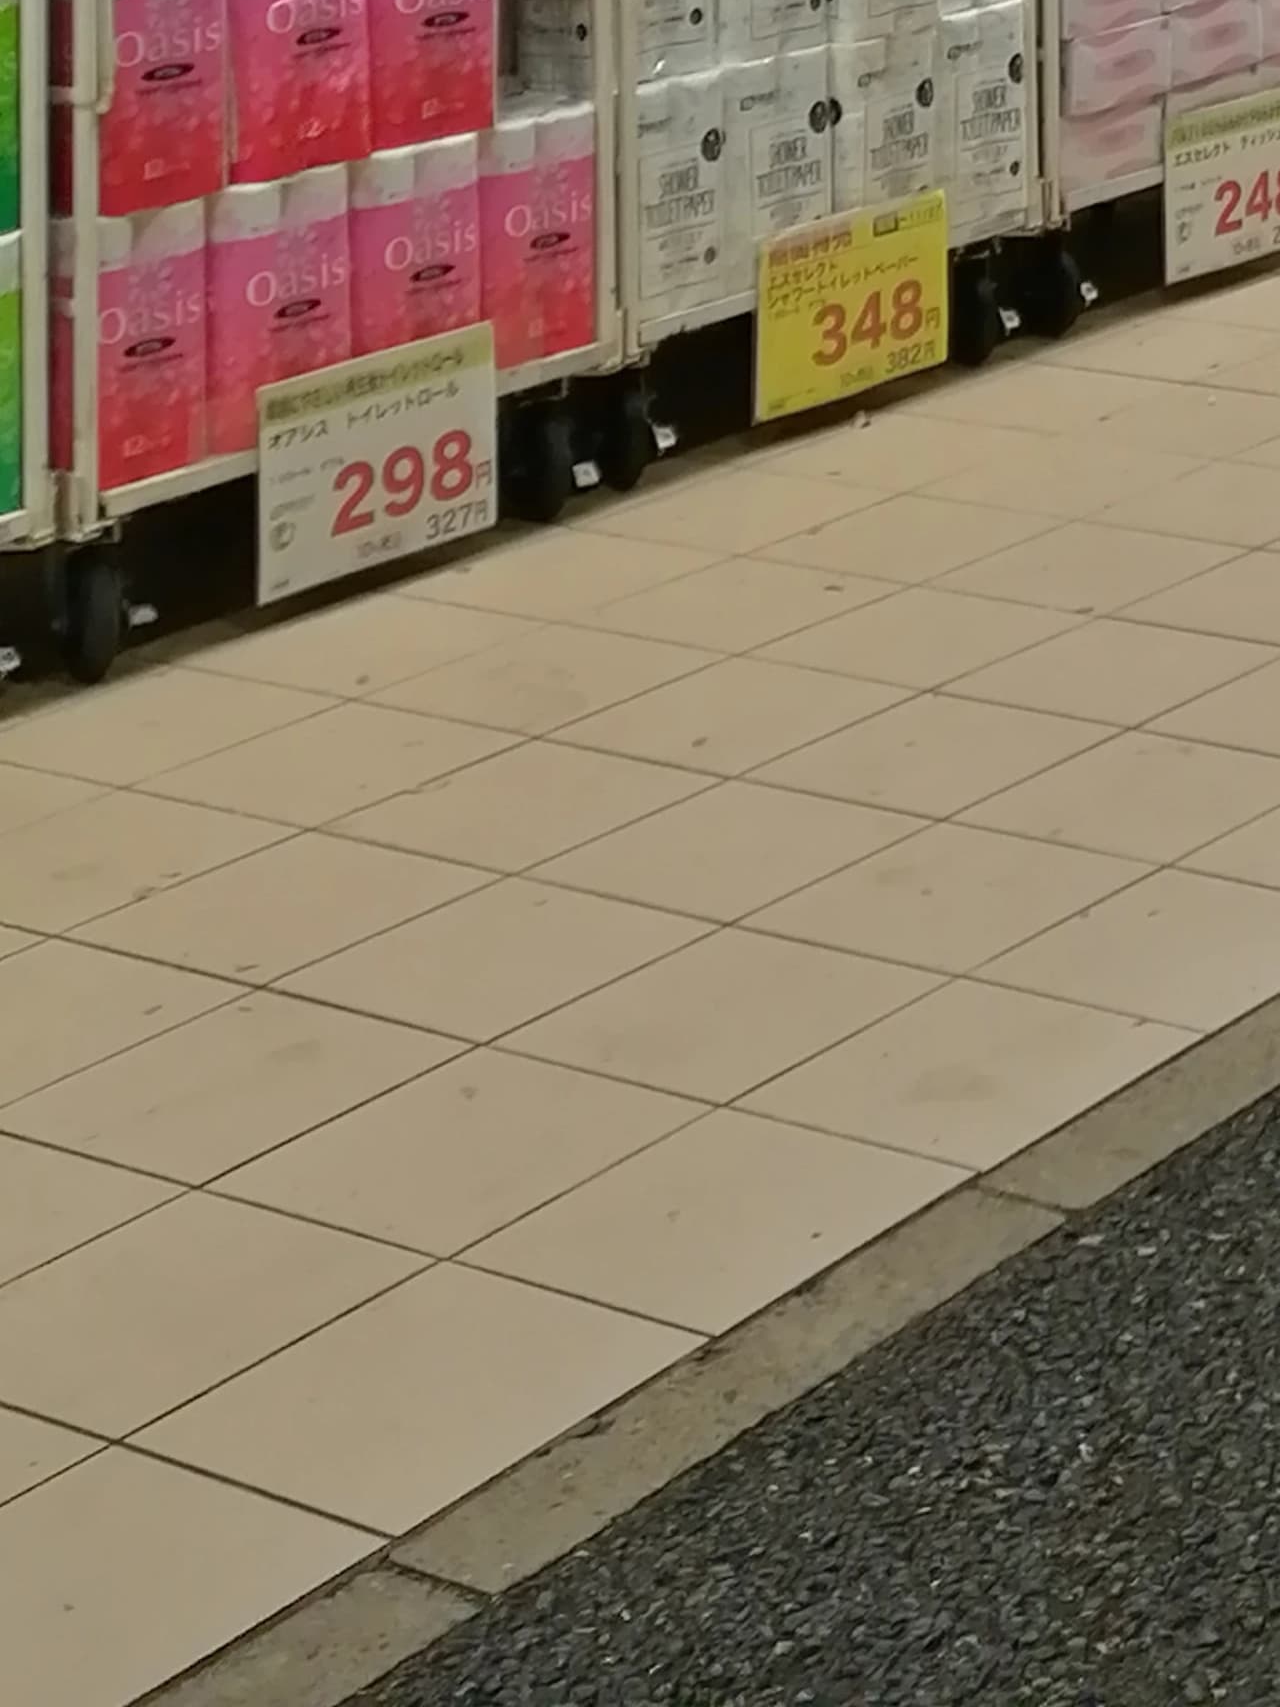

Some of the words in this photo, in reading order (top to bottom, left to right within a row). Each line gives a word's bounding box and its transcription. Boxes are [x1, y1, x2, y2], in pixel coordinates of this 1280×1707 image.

[115, 16, 224, 67] Oasis
[504, 189, 591, 238] Oasis
[384, 221, 477, 272] Oasis
[246, 253, 348, 308] Oasis
[97, 287, 201, 345] Oasis
